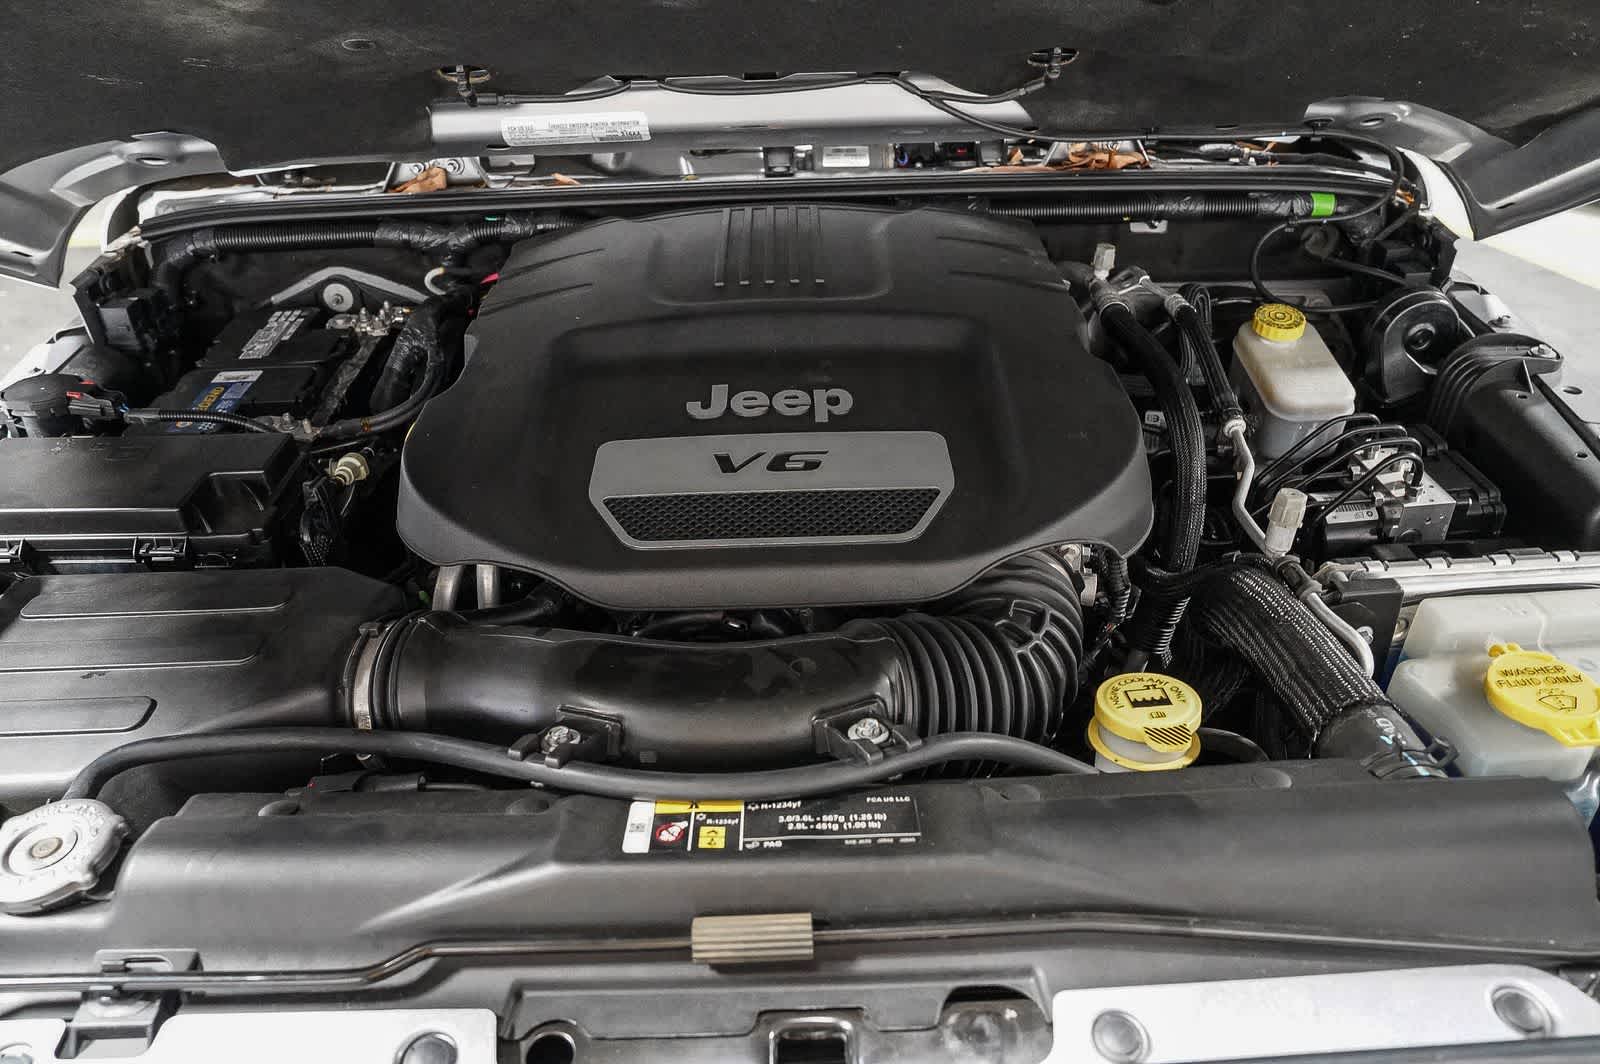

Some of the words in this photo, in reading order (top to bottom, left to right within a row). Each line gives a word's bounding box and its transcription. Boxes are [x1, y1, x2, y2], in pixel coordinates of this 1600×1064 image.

[686, 384, 853, 422] Jeep
[713, 450, 829, 473] V6
[1499, 664, 1567, 677] WASHER
[1496, 677, 1542, 689] FLUID
[1543, 674, 1584, 686] ONLY
